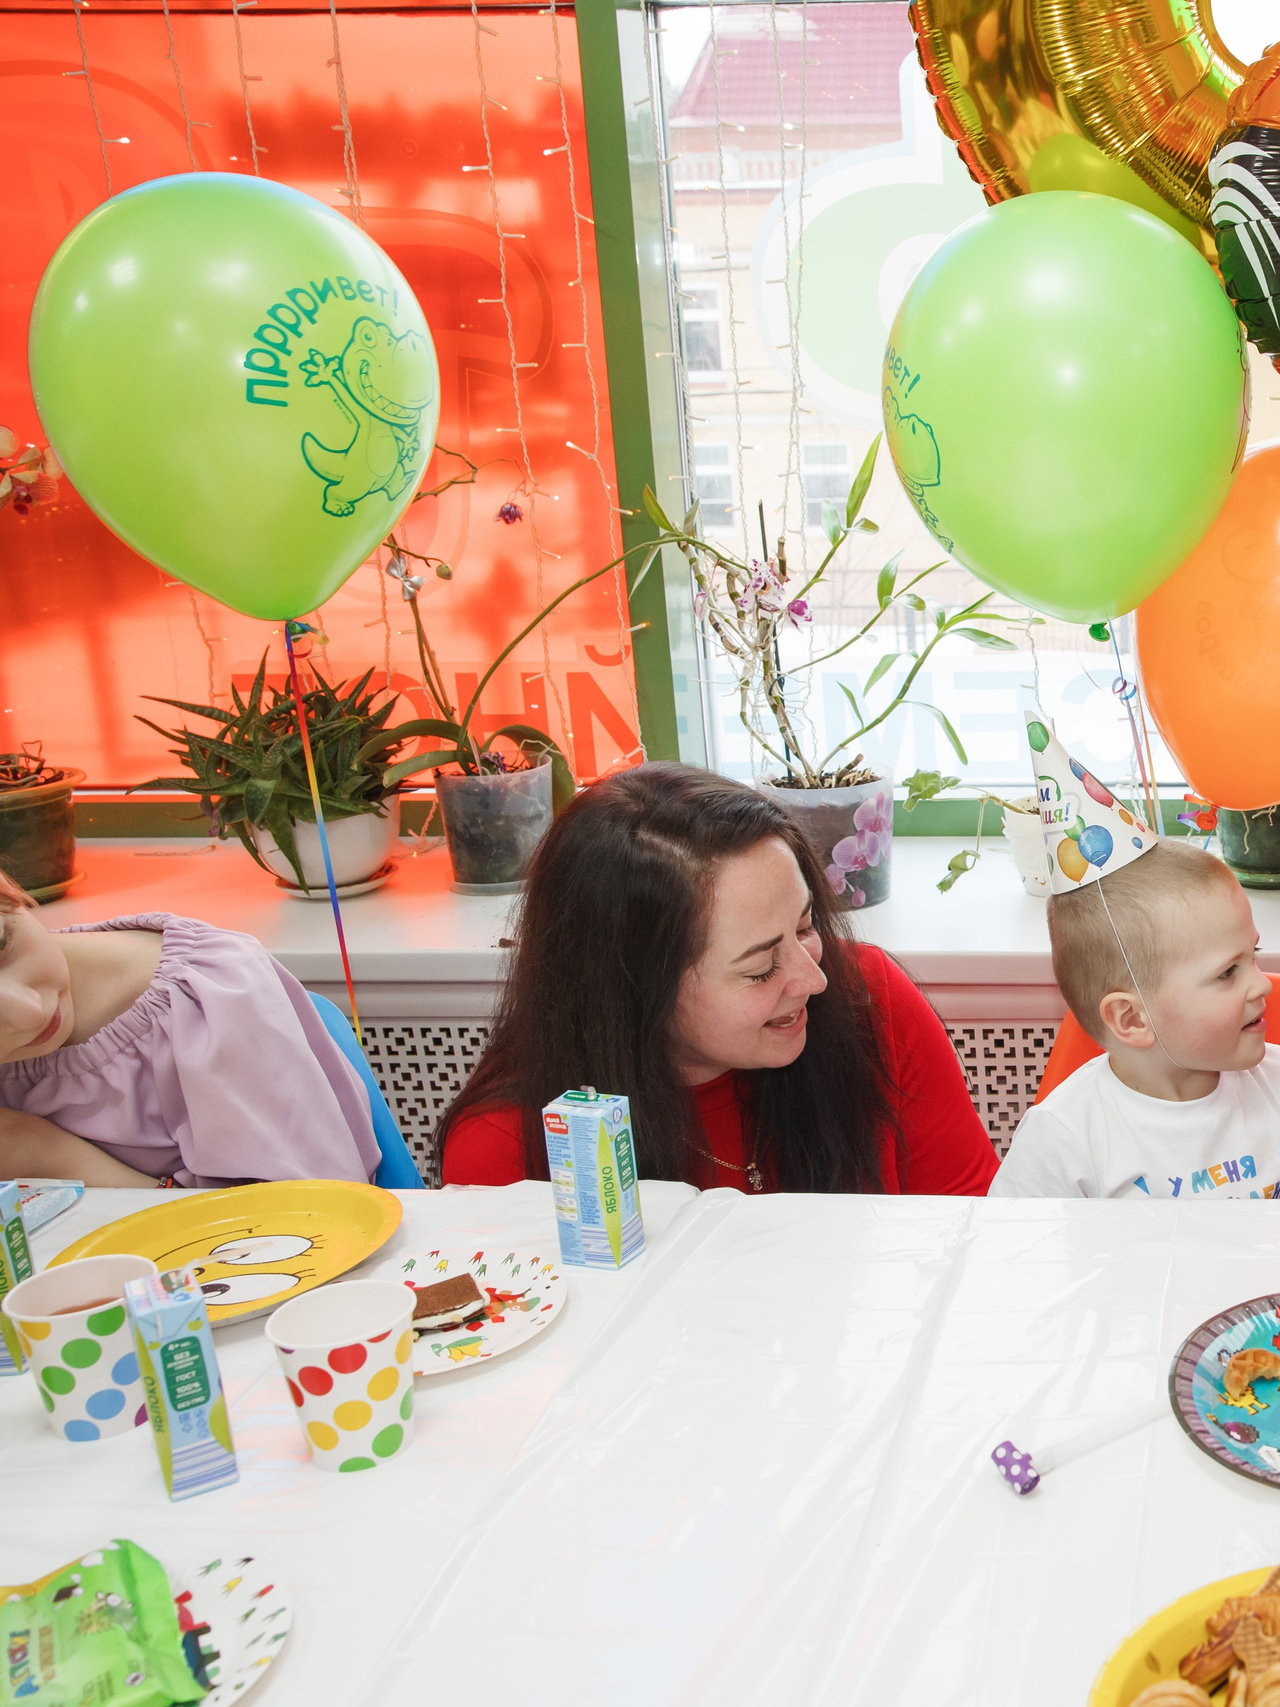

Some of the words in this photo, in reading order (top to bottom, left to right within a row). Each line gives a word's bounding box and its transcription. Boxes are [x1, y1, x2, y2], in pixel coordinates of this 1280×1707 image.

[602, 1166, 617, 1214] ЯБЛОКО
[1167, 1176, 1184, 1198] У
[1191, 1155, 1258, 1194] МЕНЯ
[175, 1370, 197, 1383] ГОСТ
[143, 1375, 164, 1433] ЯБЛОКО
